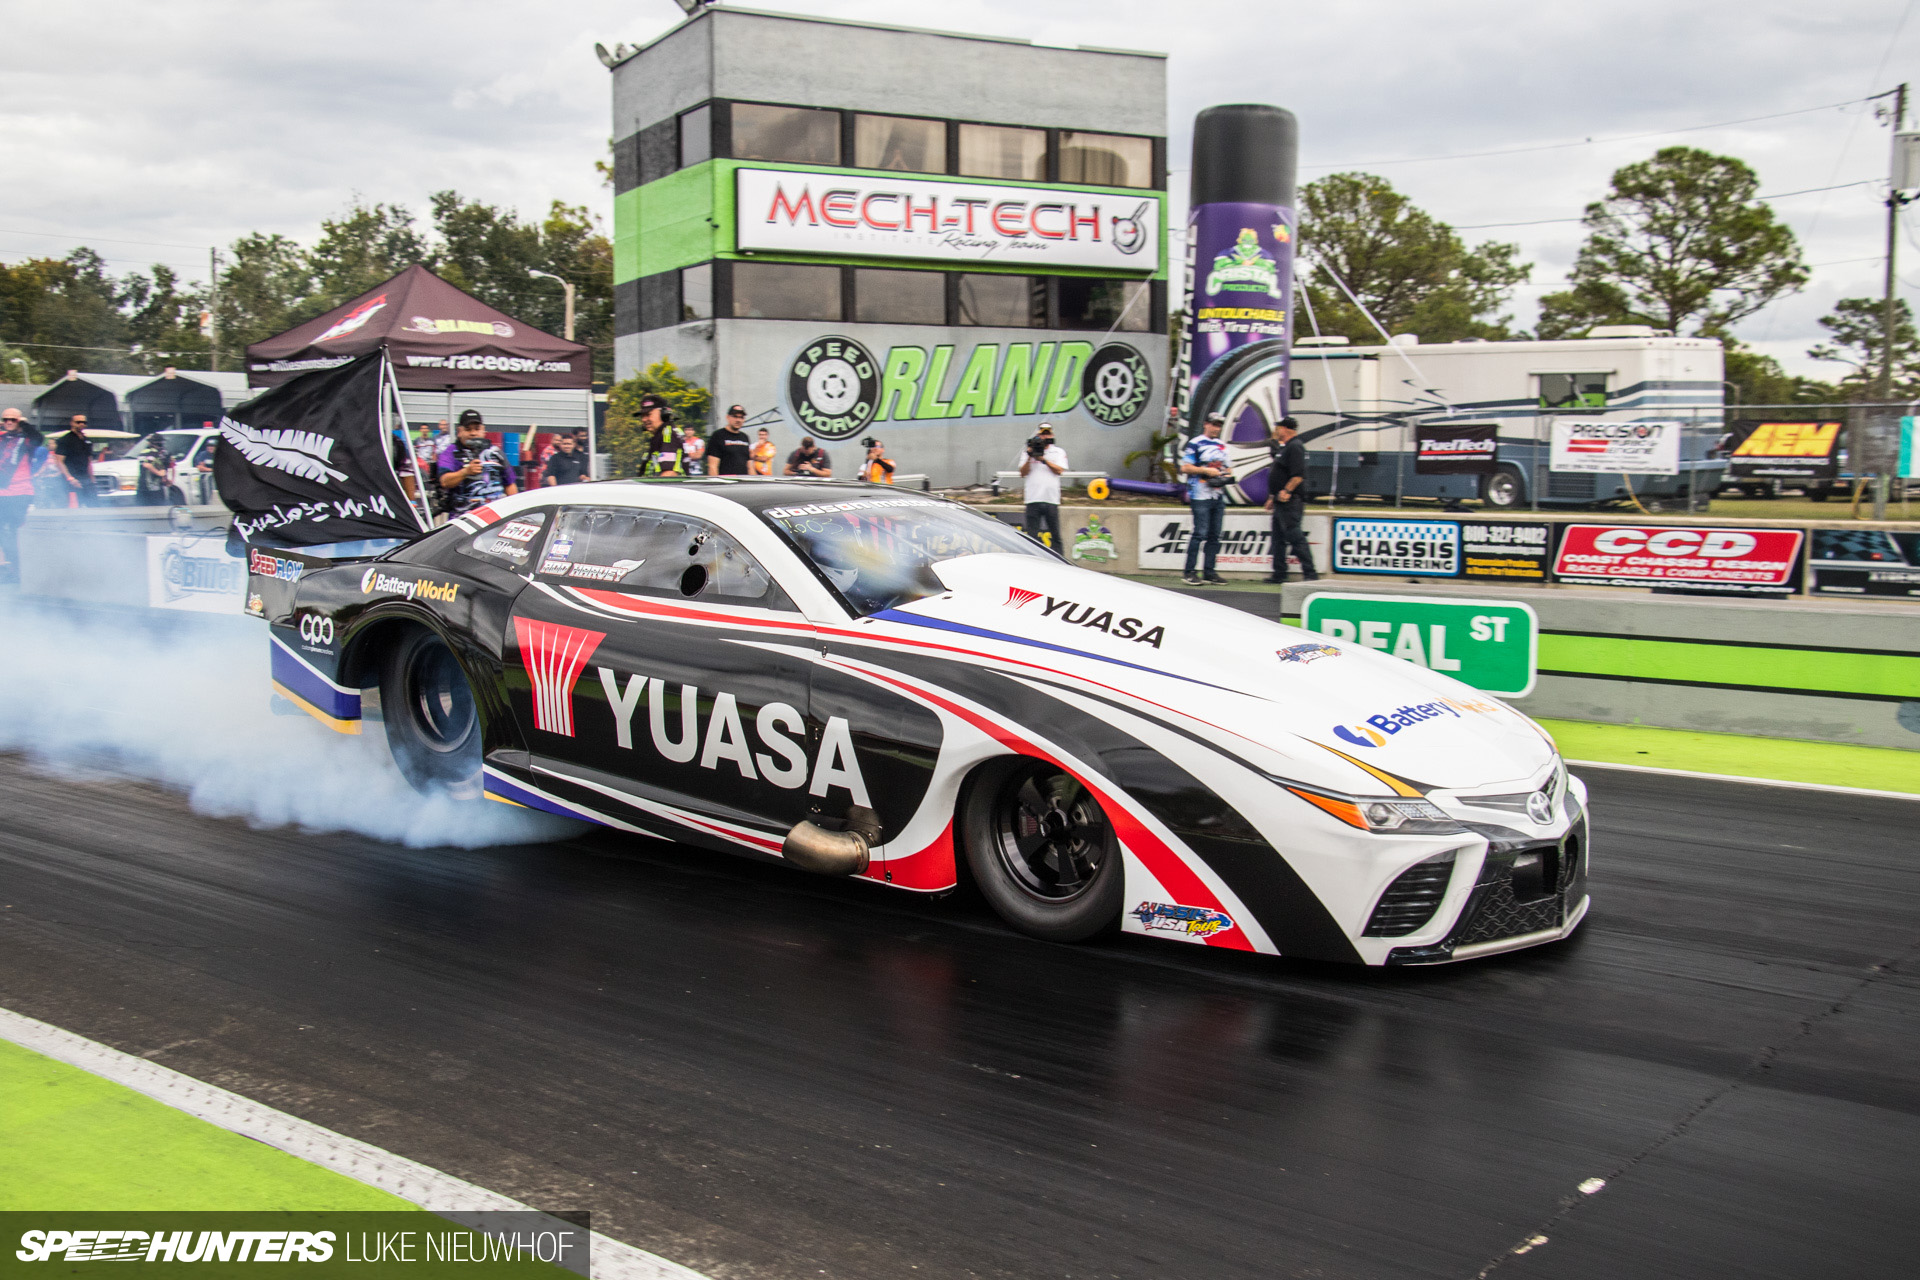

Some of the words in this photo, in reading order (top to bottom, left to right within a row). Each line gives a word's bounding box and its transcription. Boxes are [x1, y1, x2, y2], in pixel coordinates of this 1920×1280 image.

[766, 182, 1102, 242] MECH-TECH
[936, 230, 1001, 258] Racing
[1004, 231, 1051, 251] Team
[1197, 307, 1286, 322] UNTOUCHABLE
[1223, 321, 1250, 334] Tire
[1249, 322, 1286, 335] Finish
[406, 355, 571, 373] www.raceosw.com
[795, 347, 874, 381] SPEED
[1084, 355, 1149, 422] DRAGWAY
[799, 400, 871, 434] WORLD
[1419, 438, 1496, 453] FuelTech
[1732, 422, 1842, 457] AEM
[768, 499, 872, 519] dodson
[1145, 522, 1311, 556] AEMOT
[1339, 539, 1454, 558] CHASSIS
[1593, 528, 1757, 558] CCD
[250, 548, 304, 583] SPEEDFLOW
[569, 562, 629, 581] HARVEY
[1340, 556, 1454, 571] ENGINEERING
[1562, 554, 1622, 565] COAST
[1625, 556, 1709, 568] CHASSIS
[1712, 559, 1789, 571] DESIGN
[1565, 564, 1606, 574] RACE
[1607, 565, 1650, 576] CARS
[1651, 567, 1664, 577] &
[1666, 568, 1775, 581] COMPONENTS
[375, 572, 457, 602] BatteryWorld
[1040, 596, 1166, 650] YUASA
[1469, 615, 1510, 642] ST
[597, 666, 873, 809] YUASA
[1151, 917, 1189, 933] USA
